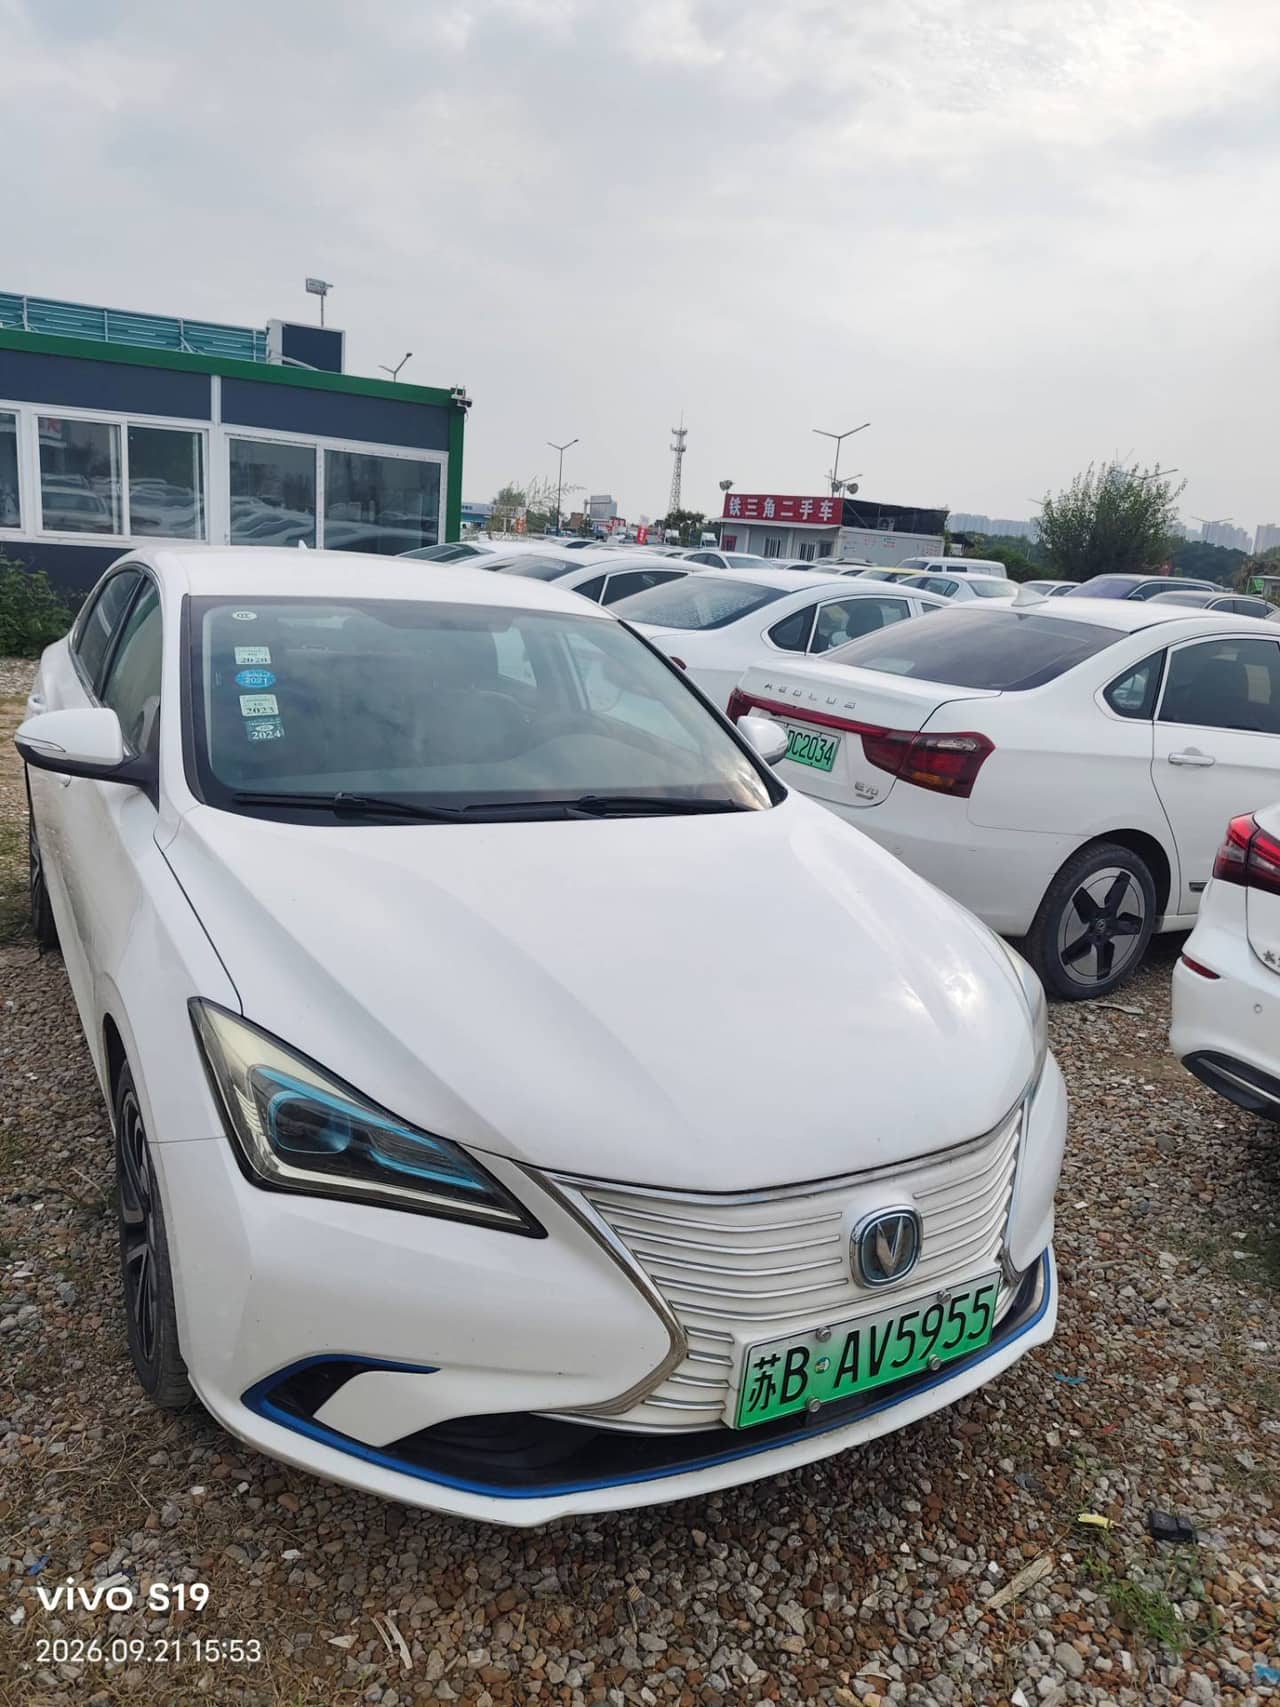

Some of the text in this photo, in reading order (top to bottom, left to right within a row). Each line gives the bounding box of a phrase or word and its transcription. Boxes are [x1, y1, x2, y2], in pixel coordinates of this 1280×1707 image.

[729, 496, 833, 521] 铁三角二手车
[251, 730, 282, 740] 2024
